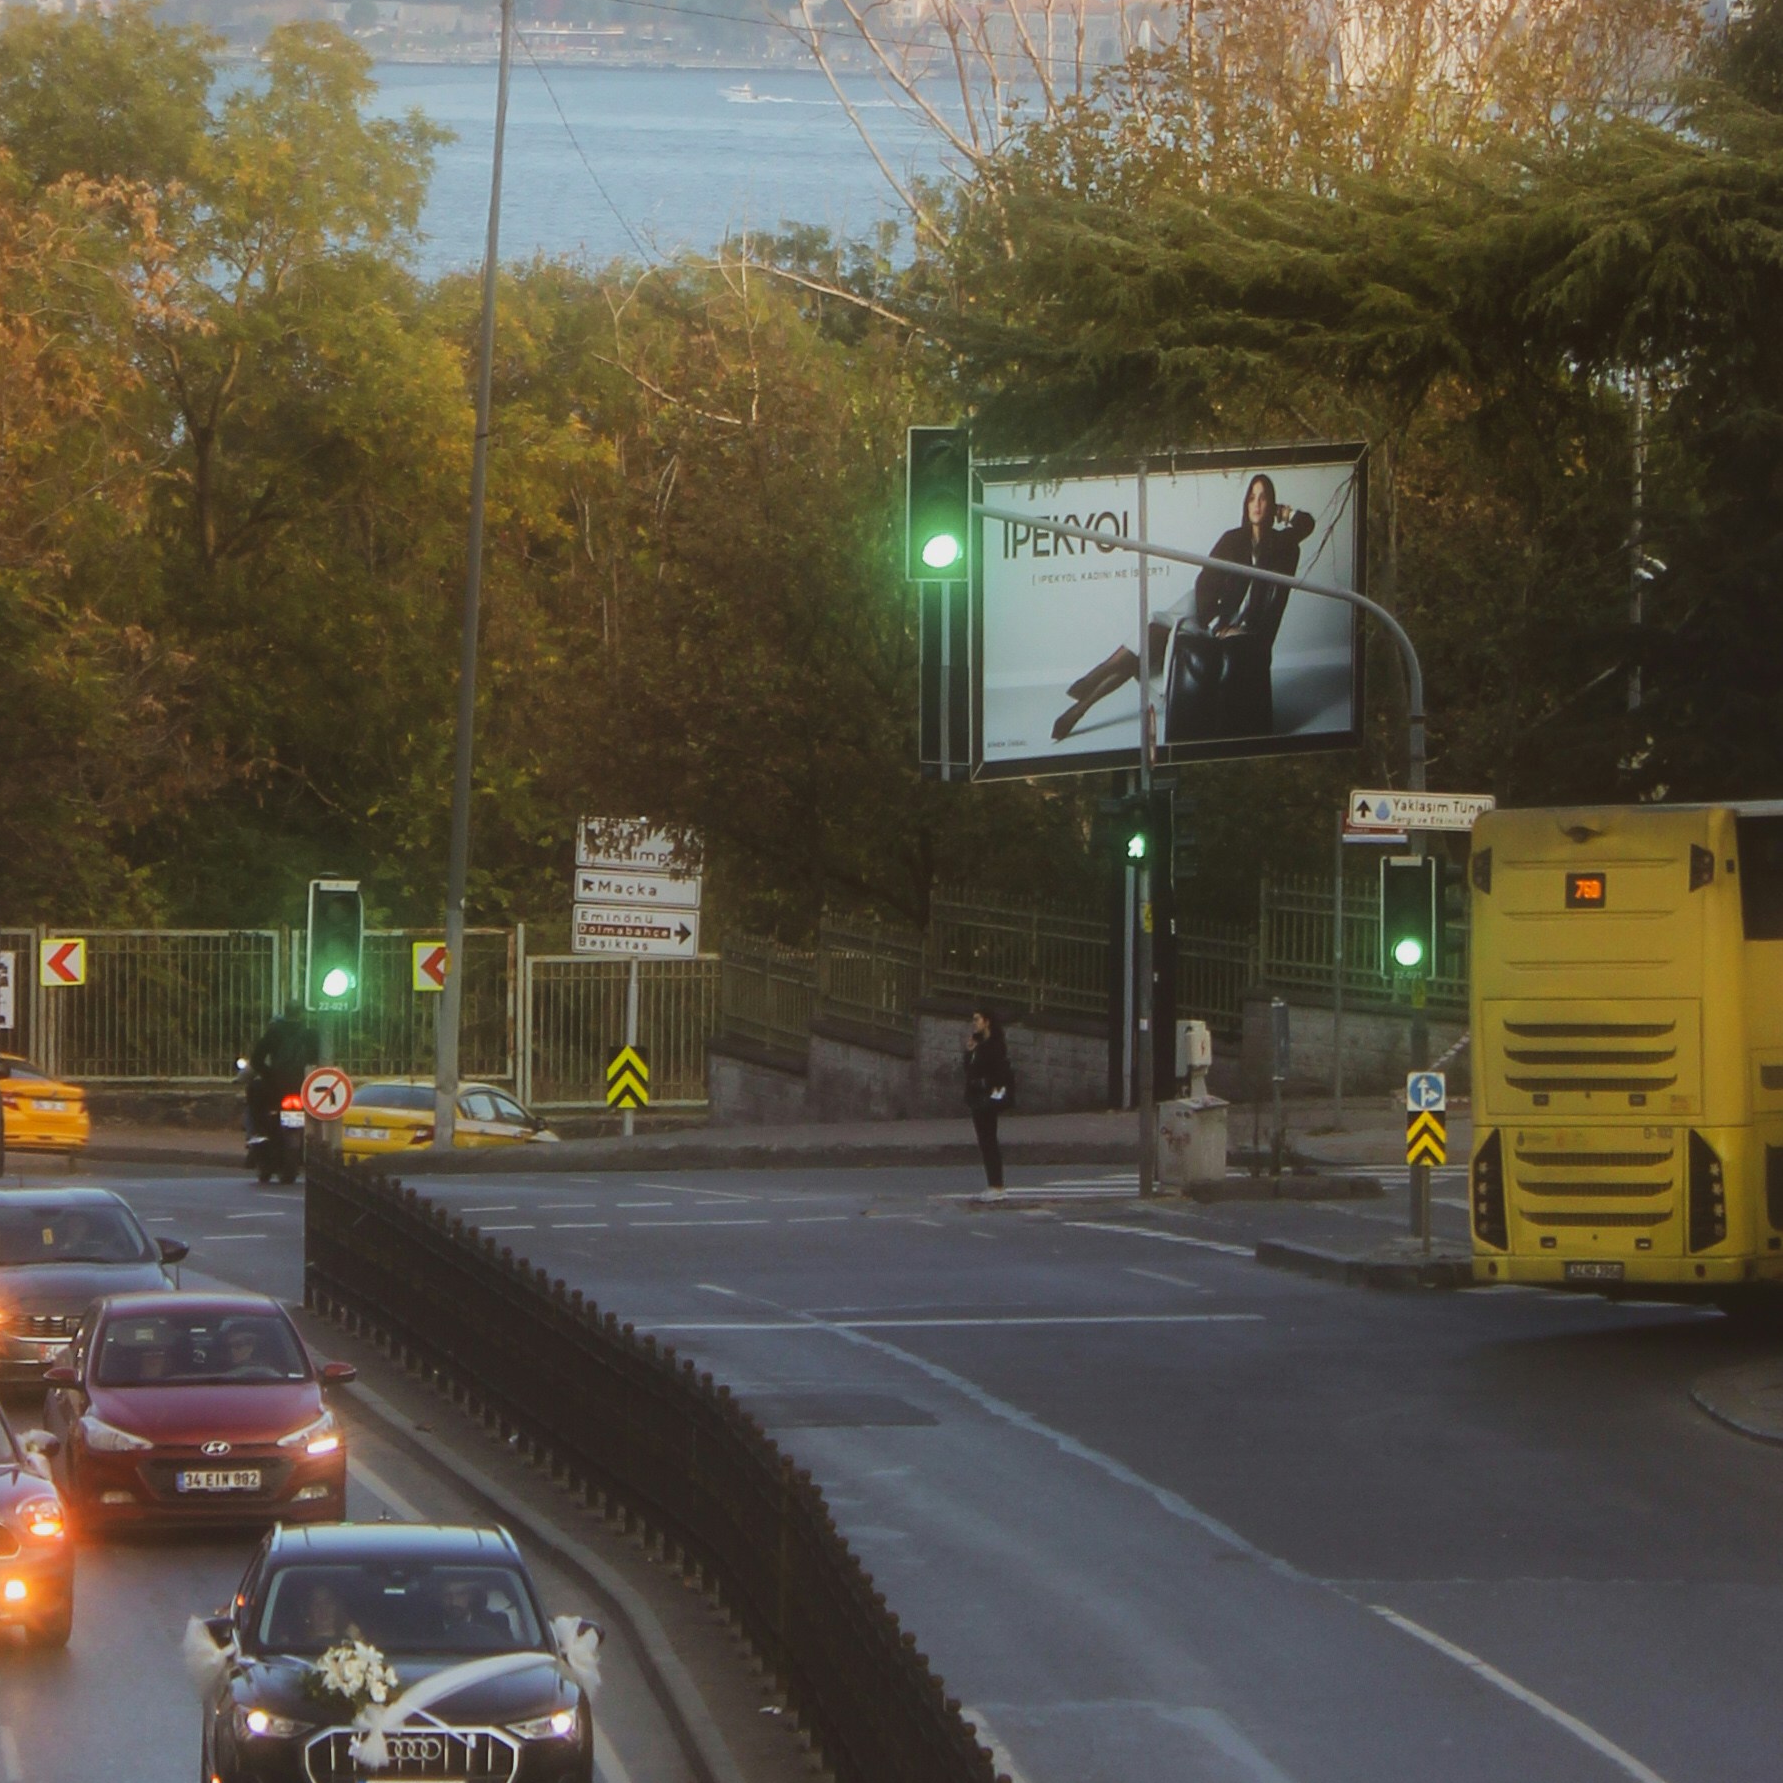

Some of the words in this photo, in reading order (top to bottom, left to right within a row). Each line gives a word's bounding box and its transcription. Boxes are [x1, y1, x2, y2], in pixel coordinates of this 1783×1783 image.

[1130, 566, 1164, 578] İSER?
[1393, 798, 1449, 813] Yaklaşım
[598, 880, 657, 896] Maçka
[581, 911, 653, 924] Eminönü
[185, 1473, 201, 1487] 34
